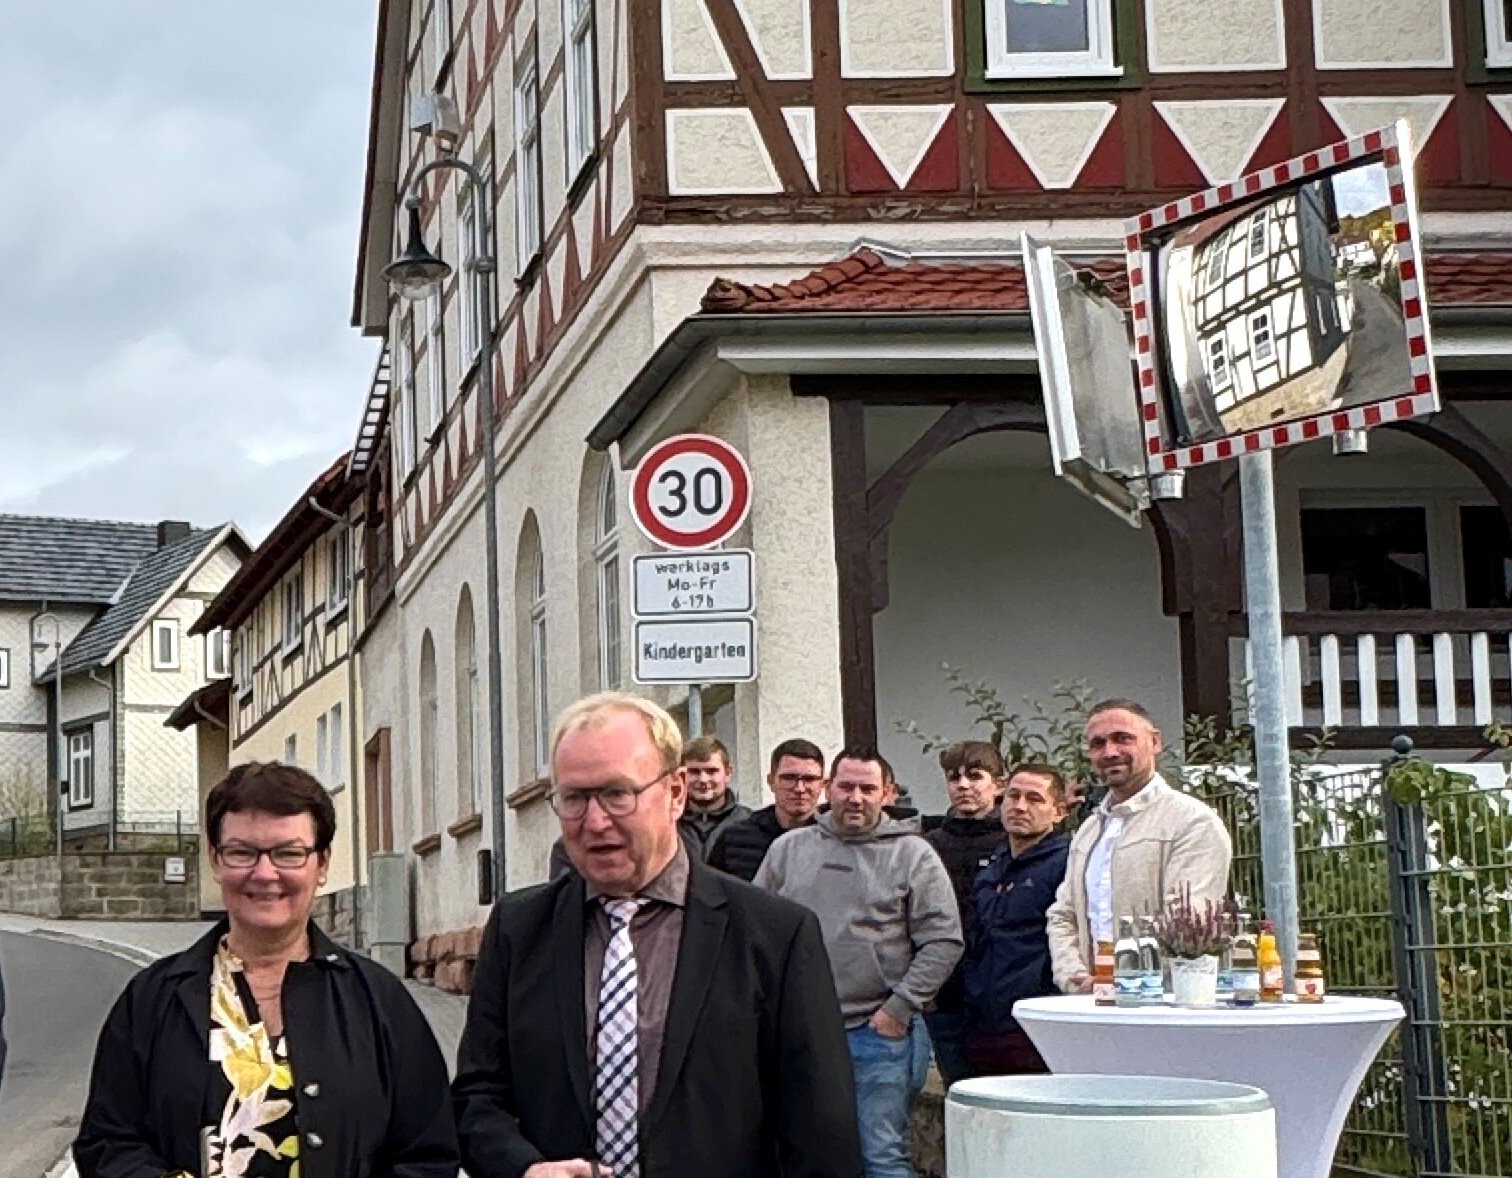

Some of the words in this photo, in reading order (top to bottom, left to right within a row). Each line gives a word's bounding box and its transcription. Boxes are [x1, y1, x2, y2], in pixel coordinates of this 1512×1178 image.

[658, 467, 723, 518] 30
[655, 559, 730, 576] werktags
[667, 576, 717, 591] Mo-Fr
[643, 642, 746, 663] Kindergarten
